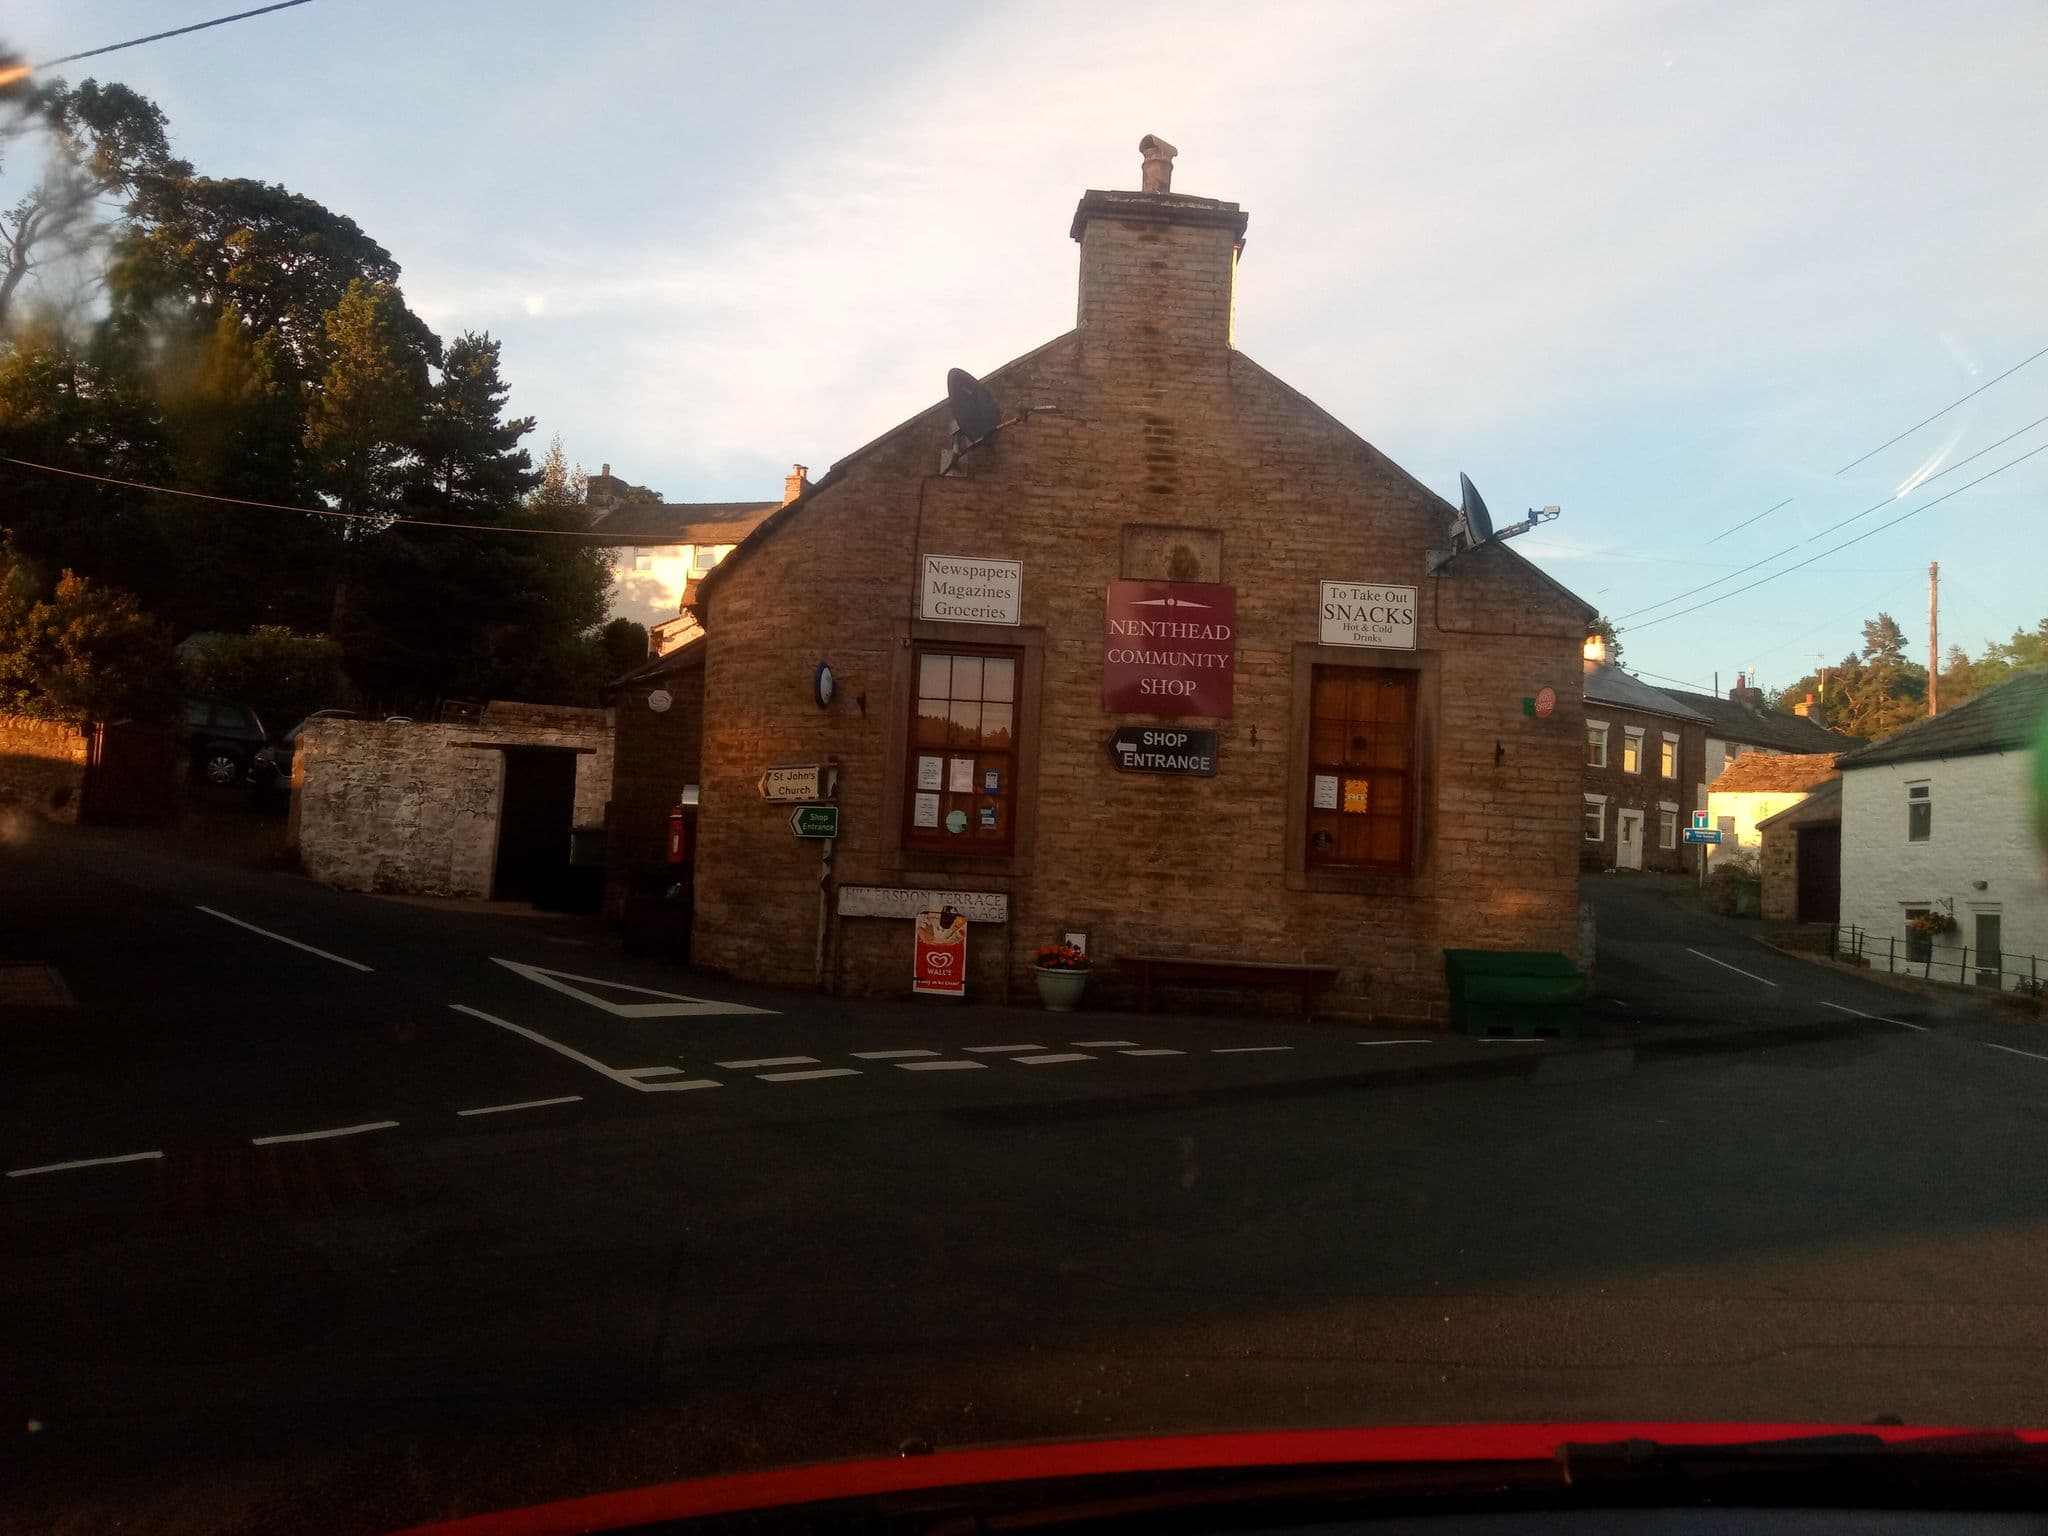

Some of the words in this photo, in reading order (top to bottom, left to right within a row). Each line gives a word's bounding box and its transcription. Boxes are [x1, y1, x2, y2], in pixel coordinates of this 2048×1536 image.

[928, 560, 1017, 580] Newspapers
[932, 581, 1011, 599] Magazines
[1330, 587, 1347, 599] To
[1351, 589, 1381, 601] Take
[1385, 591, 1407, 603] Out
[934, 601, 1006, 618] Groceries
[1323, 603, 1413, 625] SNACKS
[1109, 619, 1231, 641] NENTHEAD
[1343, 623, 1359, 631] Hot
[1361, 624, 1369, 632] &
[1372, 624, 1393, 633] Cold
[1353, 633, 1382, 642] Drinks
[1107, 649, 1229, 669] COMMUNITY
[1140, 678, 1196, 697] SHOP
[1143, 731, 1188, 747] SHOP
[1123, 752, 1211, 771] ENTRANCE
[773, 773, 783, 781] St
[787, 772, 816, 781] John's
[778, 786, 811, 795] Church
[809, 813, 829, 822] Shop
[802, 822, 835, 832] Entrance
[937, 892, 1001, 906] TERRACE
